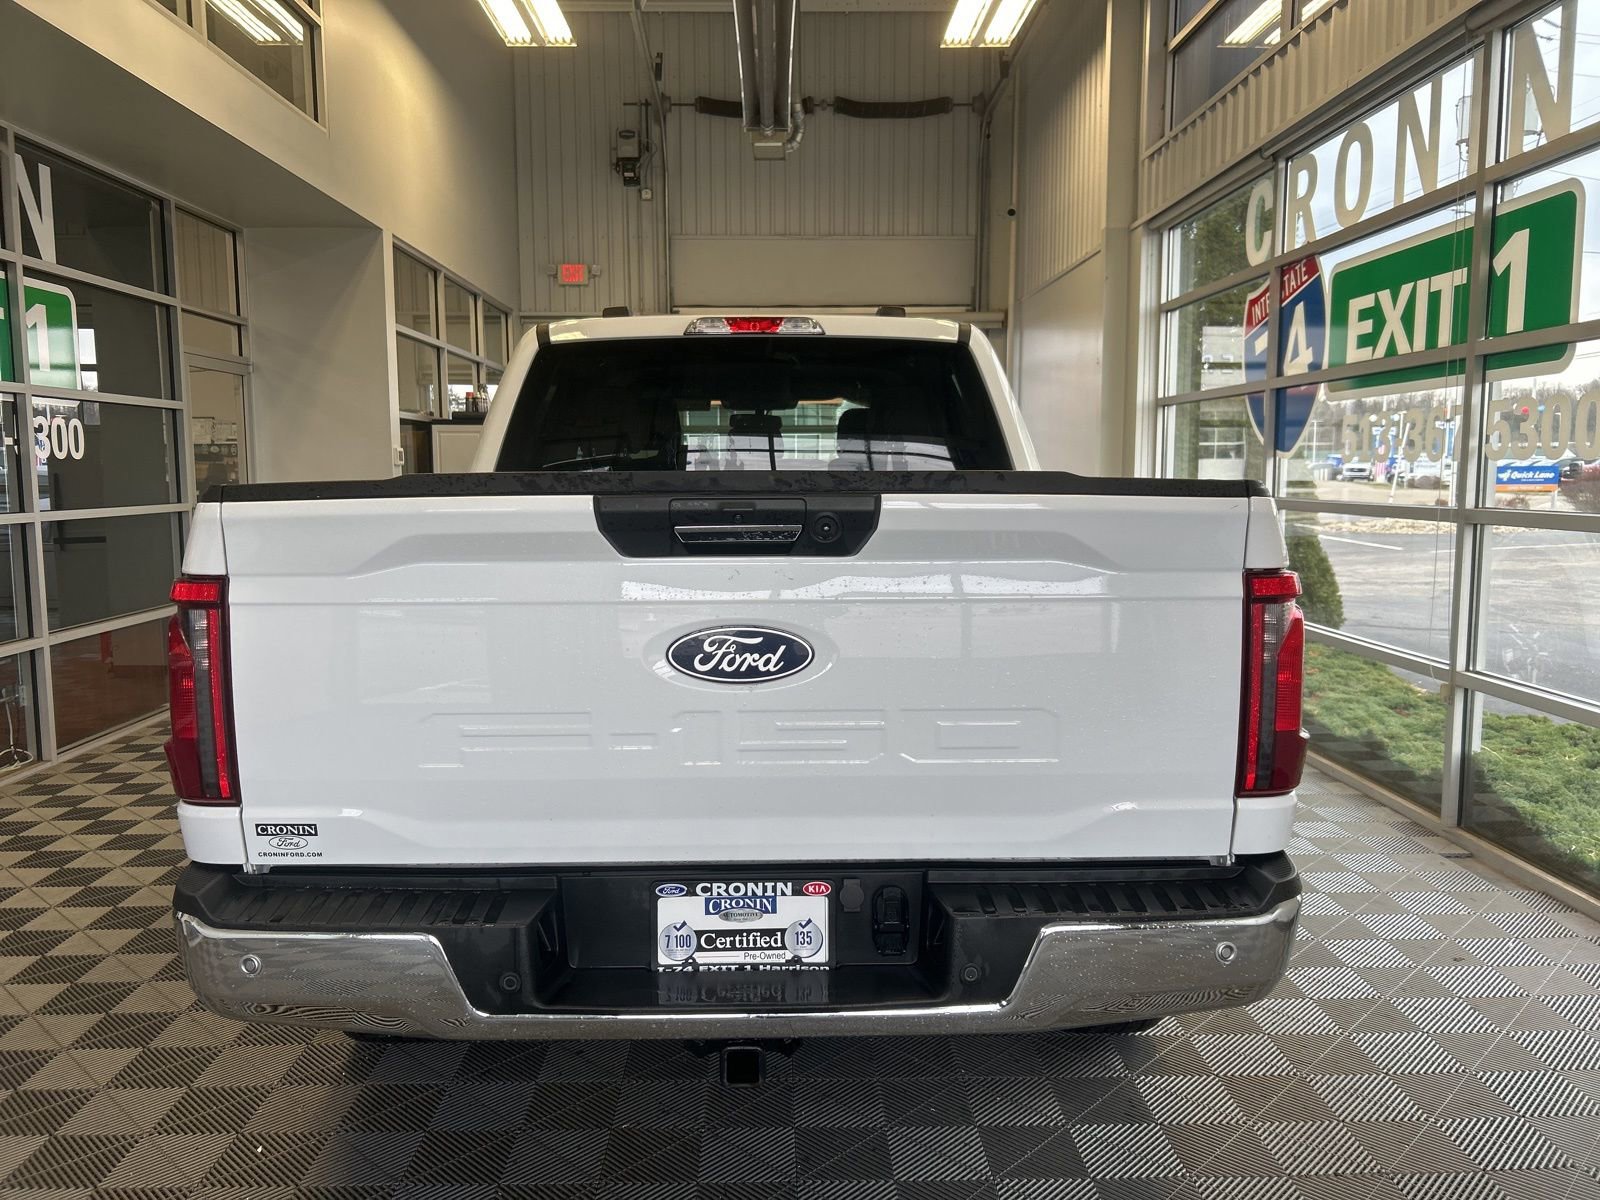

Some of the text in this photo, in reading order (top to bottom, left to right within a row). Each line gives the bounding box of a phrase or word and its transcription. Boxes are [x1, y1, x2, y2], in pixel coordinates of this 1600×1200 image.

[562, 263, 584, 282] EXIT
[1346, 228, 1530, 365] EXIT 1
[1511, 470, 1554, 479] Quick Lane
[693, 634, 785, 672] Ford
[417, 708, 1061, 767] F-150
[258, 825, 315, 835] CRONIN
[277, 838, 300, 847] Ford
[662, 882, 827, 896] Ford CRONIN KIA
[708, 898, 773, 914] CRONIN
[664, 934, 692, 949] 7 100
[700, 931, 783, 949] Certified
[795, 931, 812, 945] 135
[743, 951, 786, 961] Pre-Owned
